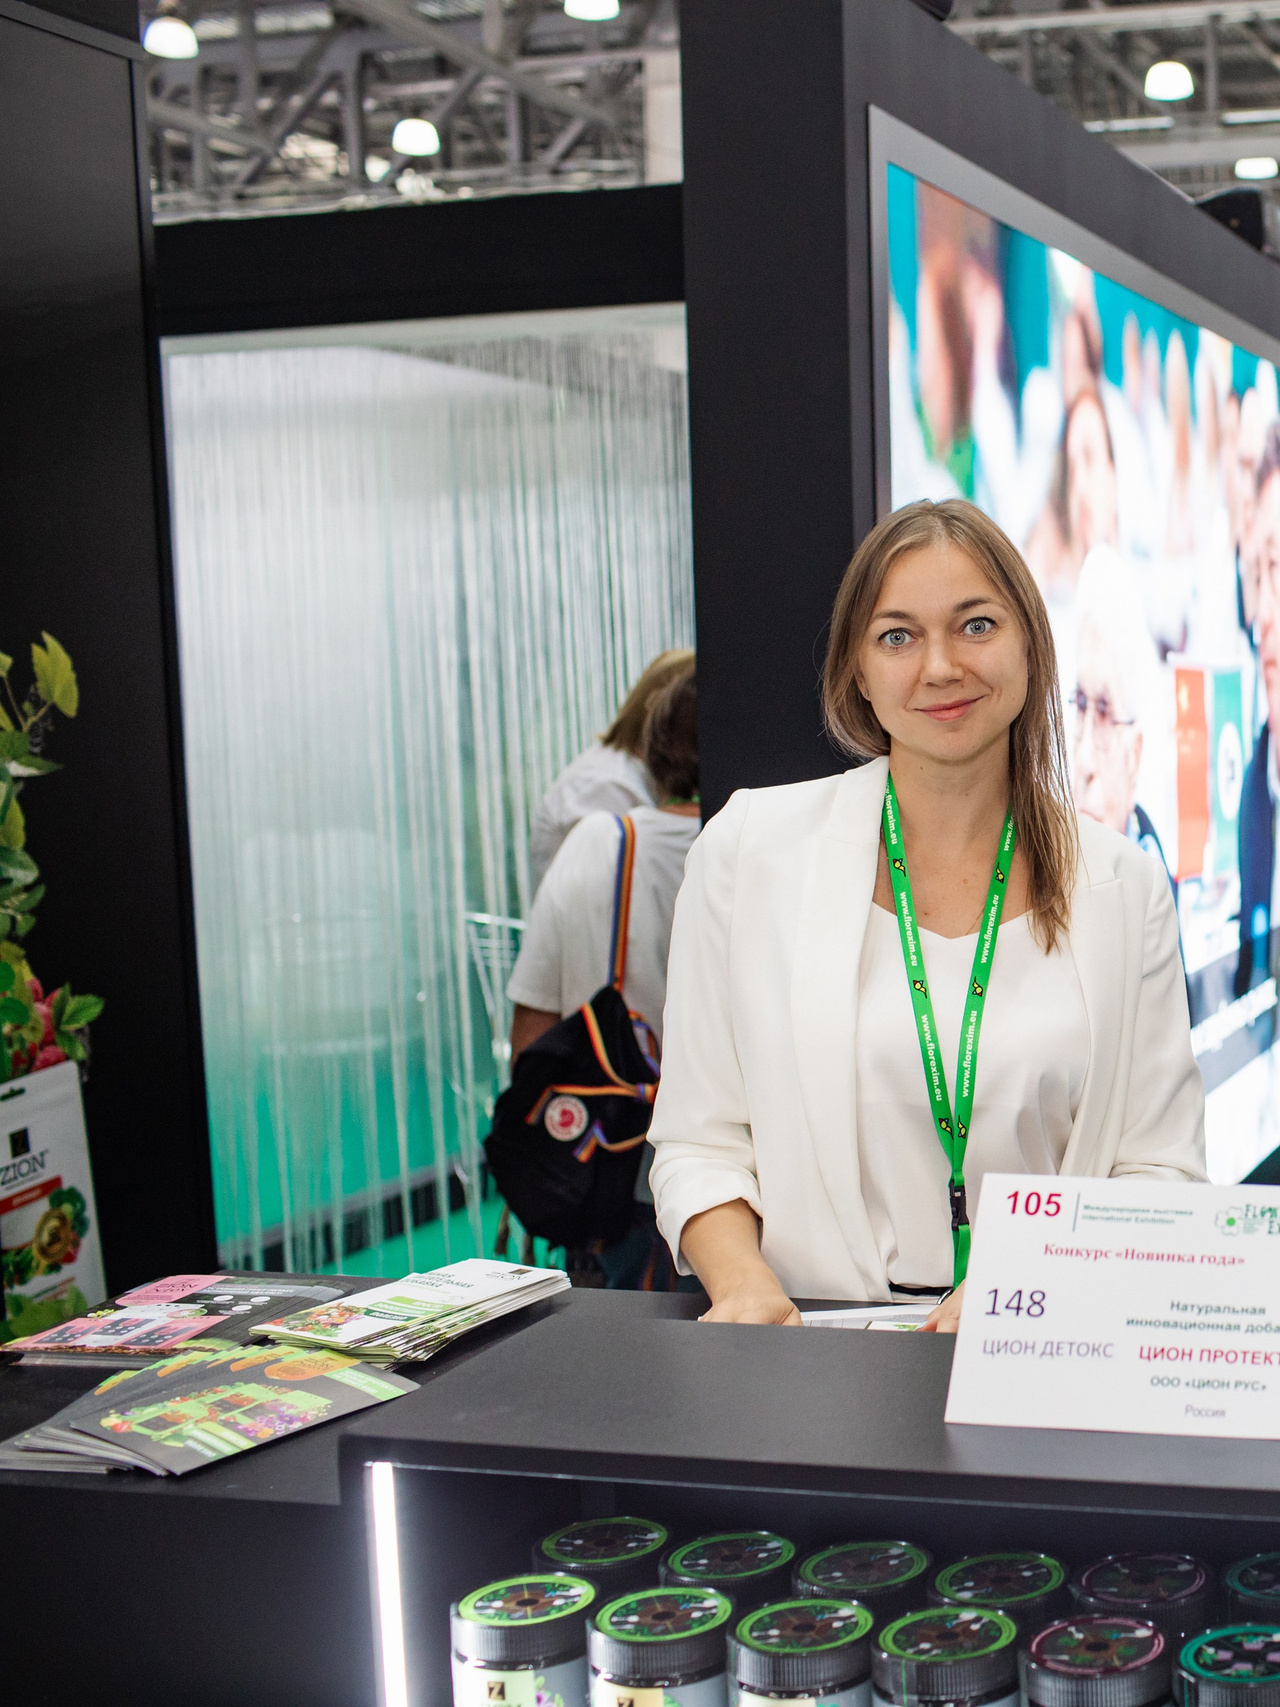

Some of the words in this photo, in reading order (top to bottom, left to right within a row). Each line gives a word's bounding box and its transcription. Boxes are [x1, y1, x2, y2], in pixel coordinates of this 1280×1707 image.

[899, 891, 918, 968] www.florexim.eu
[981, 894, 999, 964] www.florexim.eu
[921, 1014, 943, 1102] www.florexim.eu
[962, 1010, 978, 1098] www.florexim.eu
[1006, 1190, 1062, 1217] 105
[1153, 1208, 1194, 1217] выставка
[1082, 1214, 1131, 1224] International
[1134, 1216, 1176, 1226] Exhibition
[1043, 1243, 1112, 1261] Конкурс
[1115, 1247, 1196, 1265] «Новинка
[1200, 1253, 1246, 1268] года»
[984, 1288, 1047, 1318] 148
[1170, 1300, 1267, 1316] Натуральная
[1126, 1317, 1242, 1333] инновационная
[982, 1338, 1036, 1357] ЦИОН
[1039, 1340, 1115, 1359] ДЕТОКС
[1139, 1345, 1194, 1363] ЦИОН
[1150, 1375, 1181, 1388] ООО
[1185, 1378, 1231, 1392] «ЦИОН
[1234, 1380, 1267, 1393] РУС»
[1184, 1404, 1227, 1419] Россия
